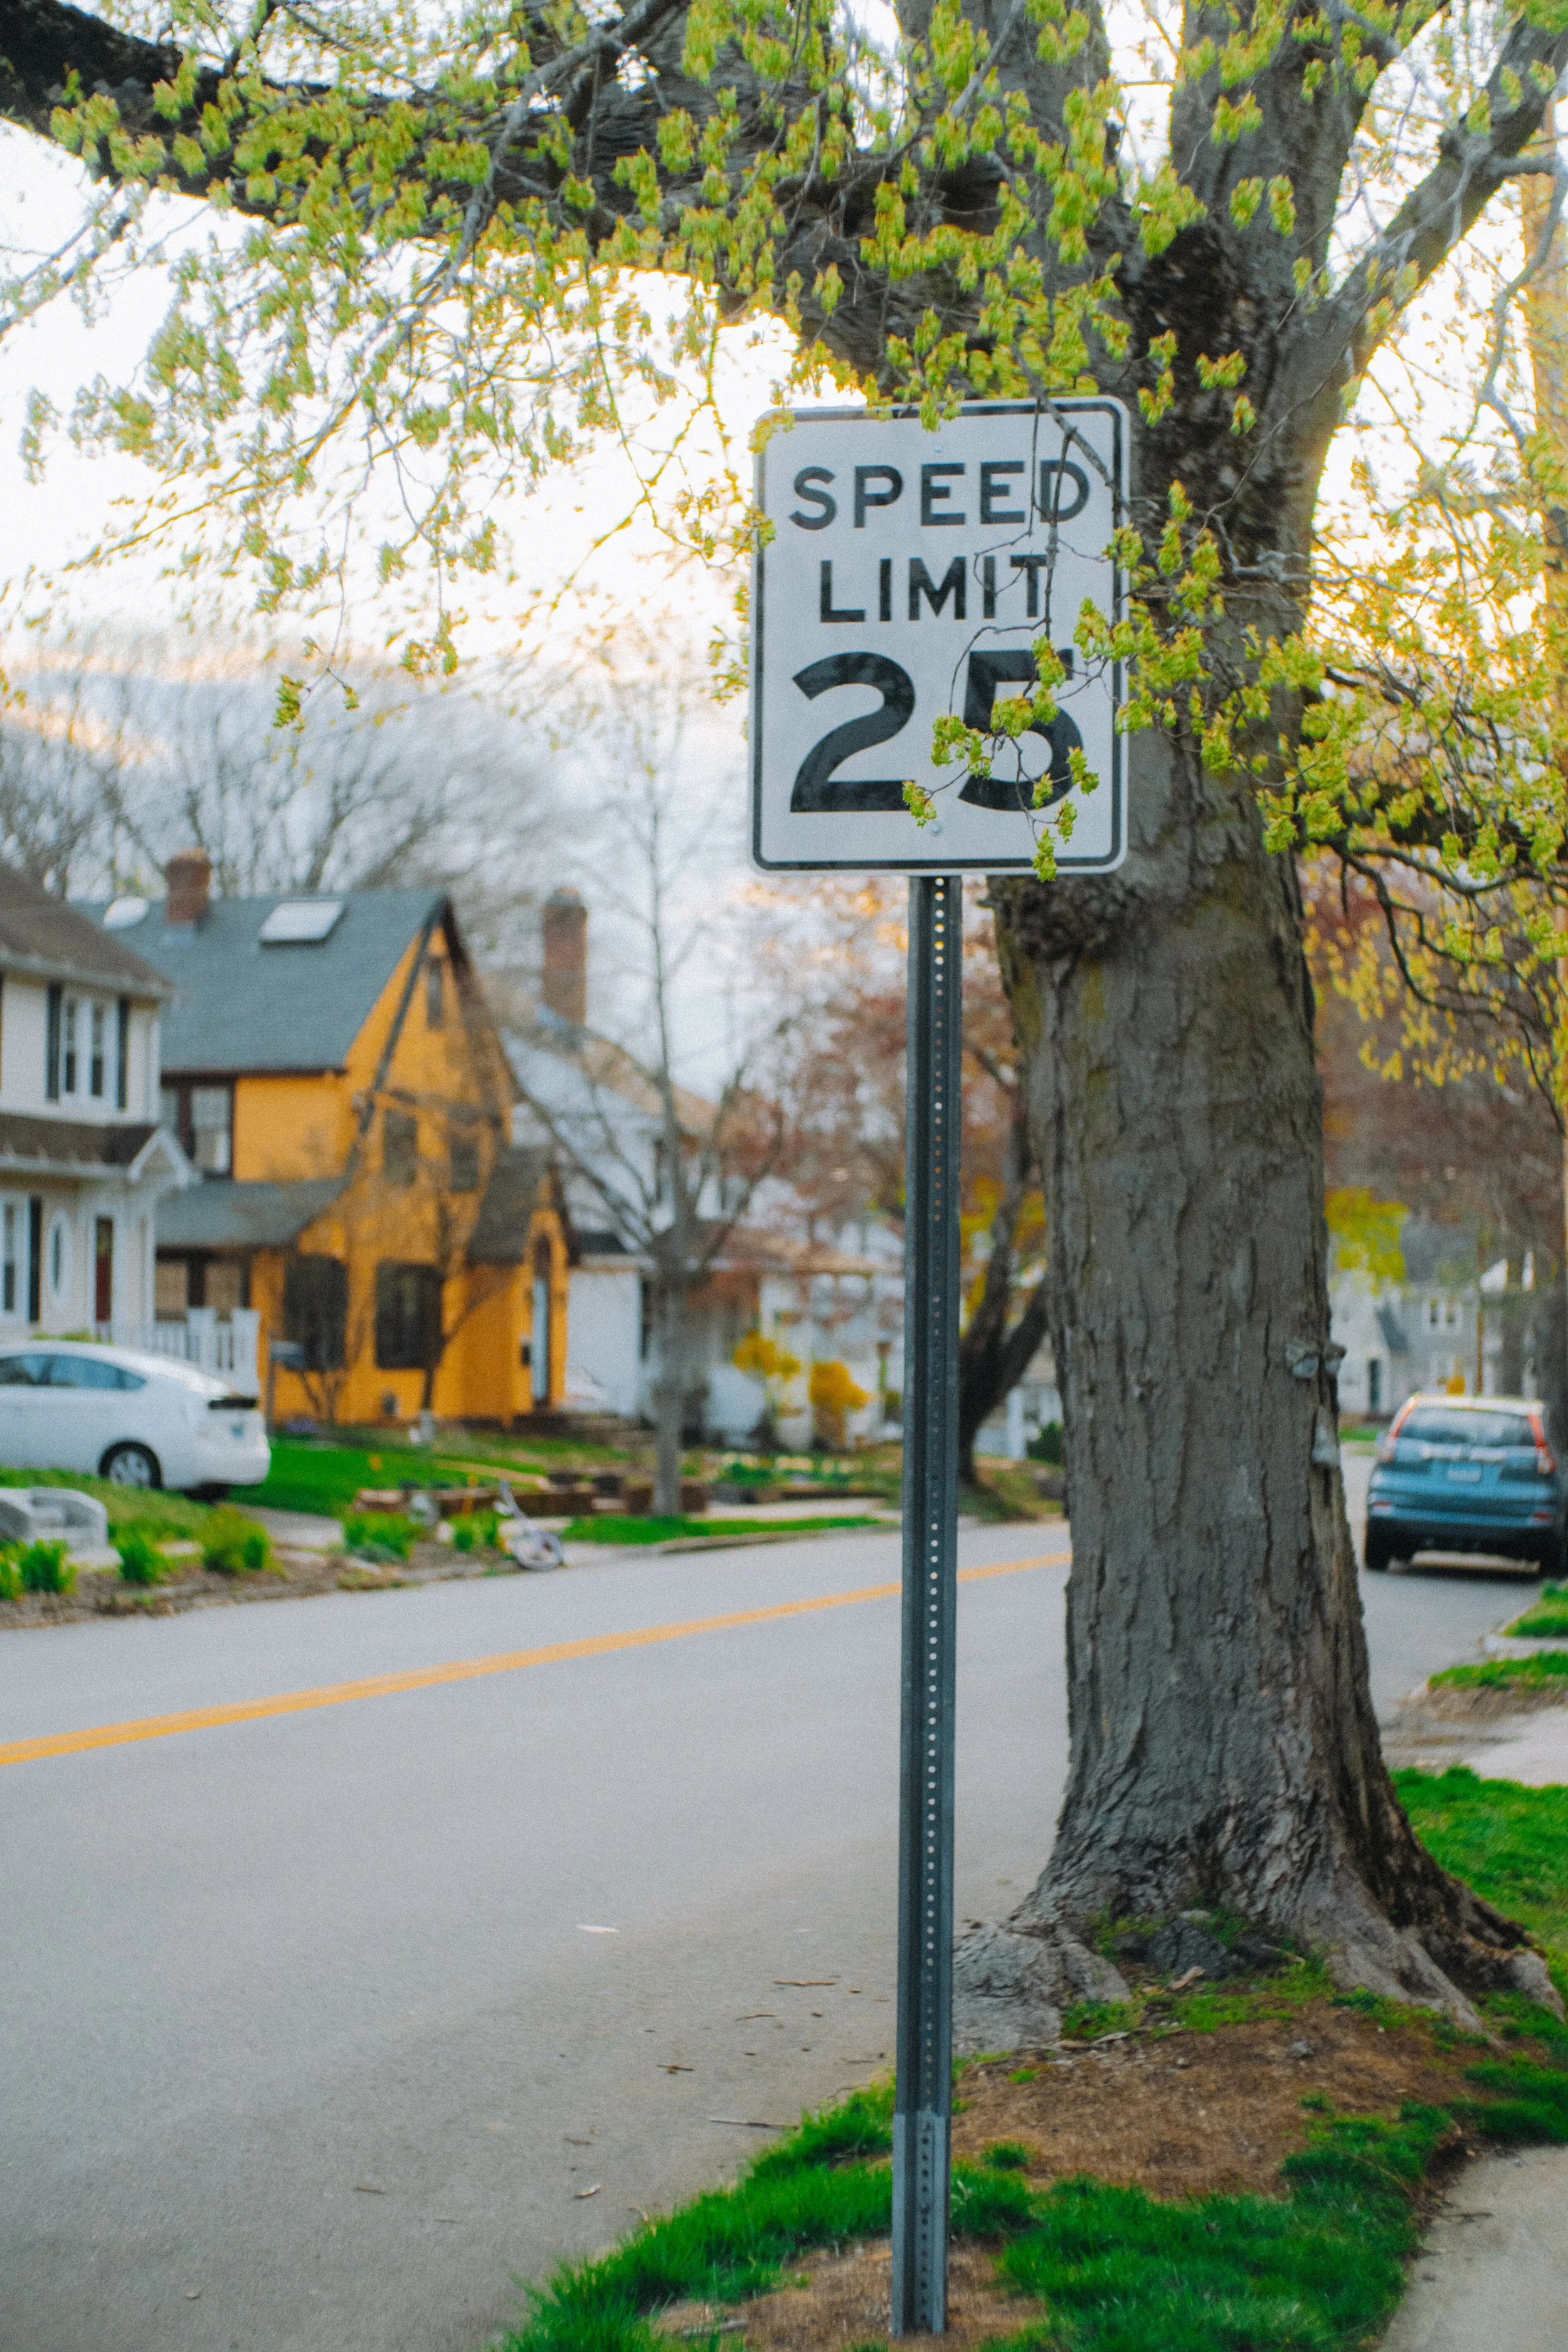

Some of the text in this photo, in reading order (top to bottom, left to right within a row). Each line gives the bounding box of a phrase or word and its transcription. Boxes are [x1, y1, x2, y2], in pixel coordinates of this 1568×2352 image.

[788, 459, 1089, 531] SPEED
[819, 554, 1049, 623] LIMIT
[790, 649, 1083, 813] 25
